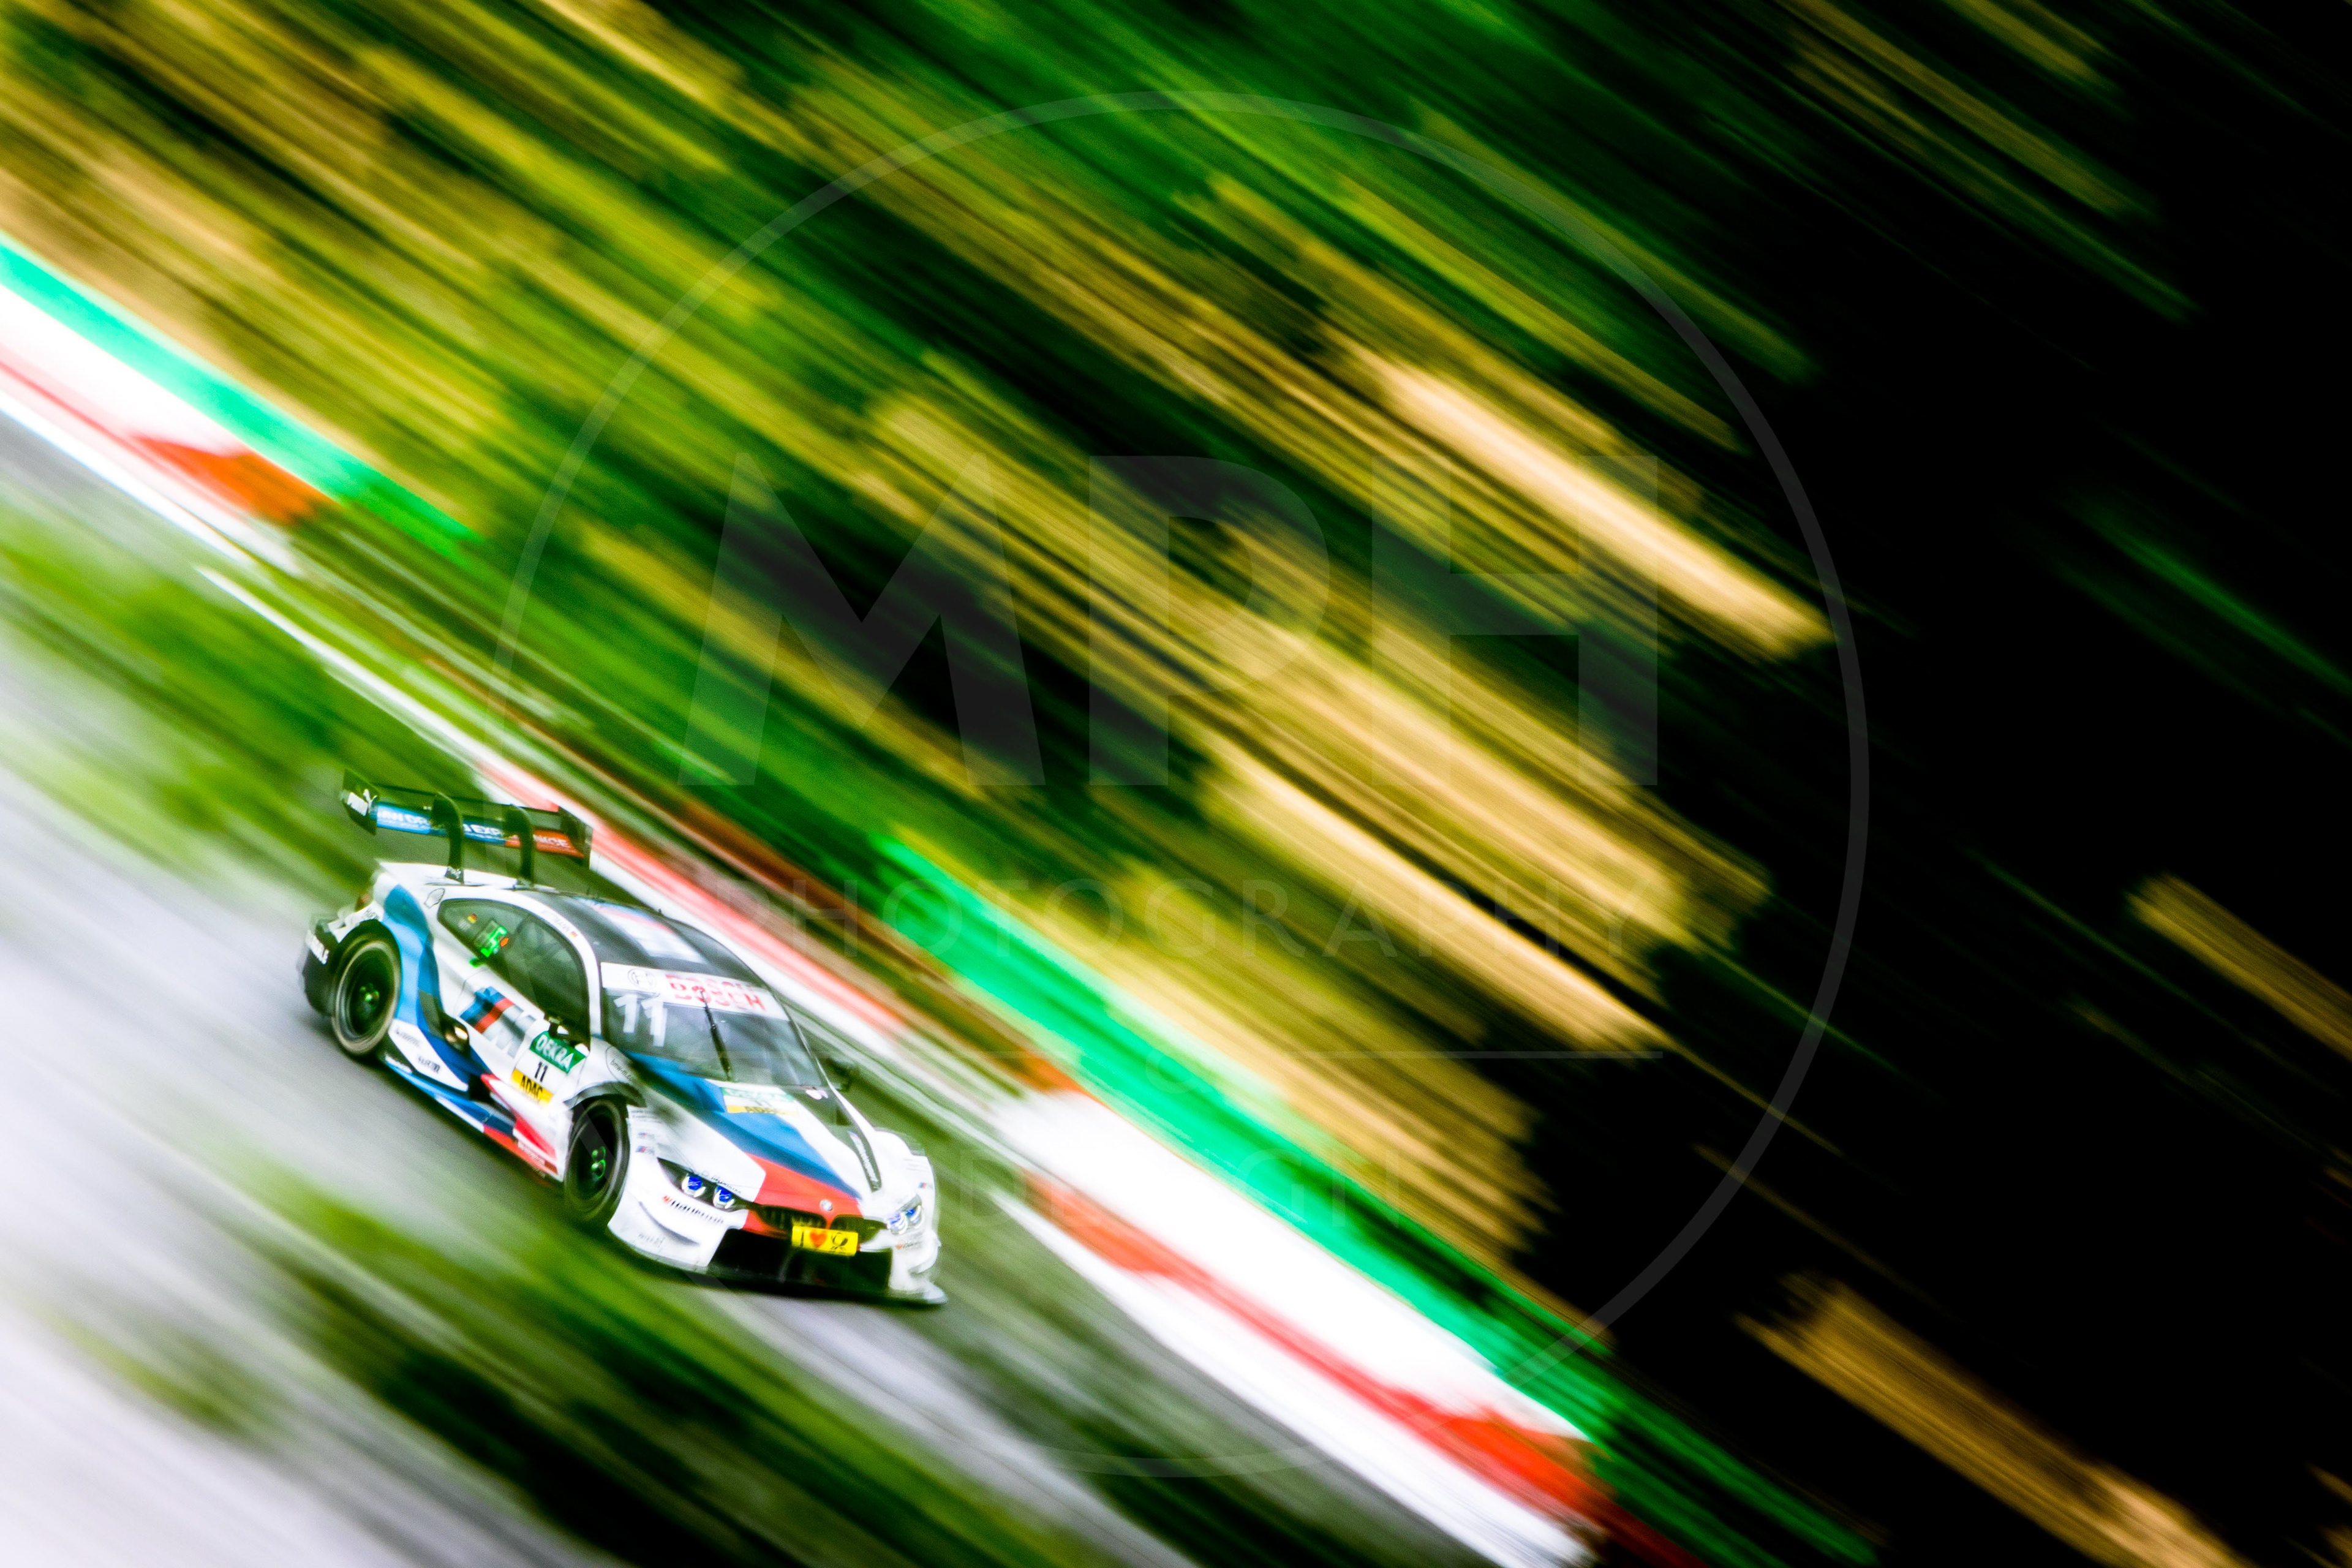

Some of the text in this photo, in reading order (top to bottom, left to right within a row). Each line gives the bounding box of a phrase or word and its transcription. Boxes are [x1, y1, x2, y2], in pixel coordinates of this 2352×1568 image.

[668, 978, 766, 1012] BOSCH
[613, 993, 668, 1047] 11
[535, 1033, 575, 1072] DEKRA
[520, 1074, 543, 1099] ADAC
[535, 1061, 549, 1083] 11
